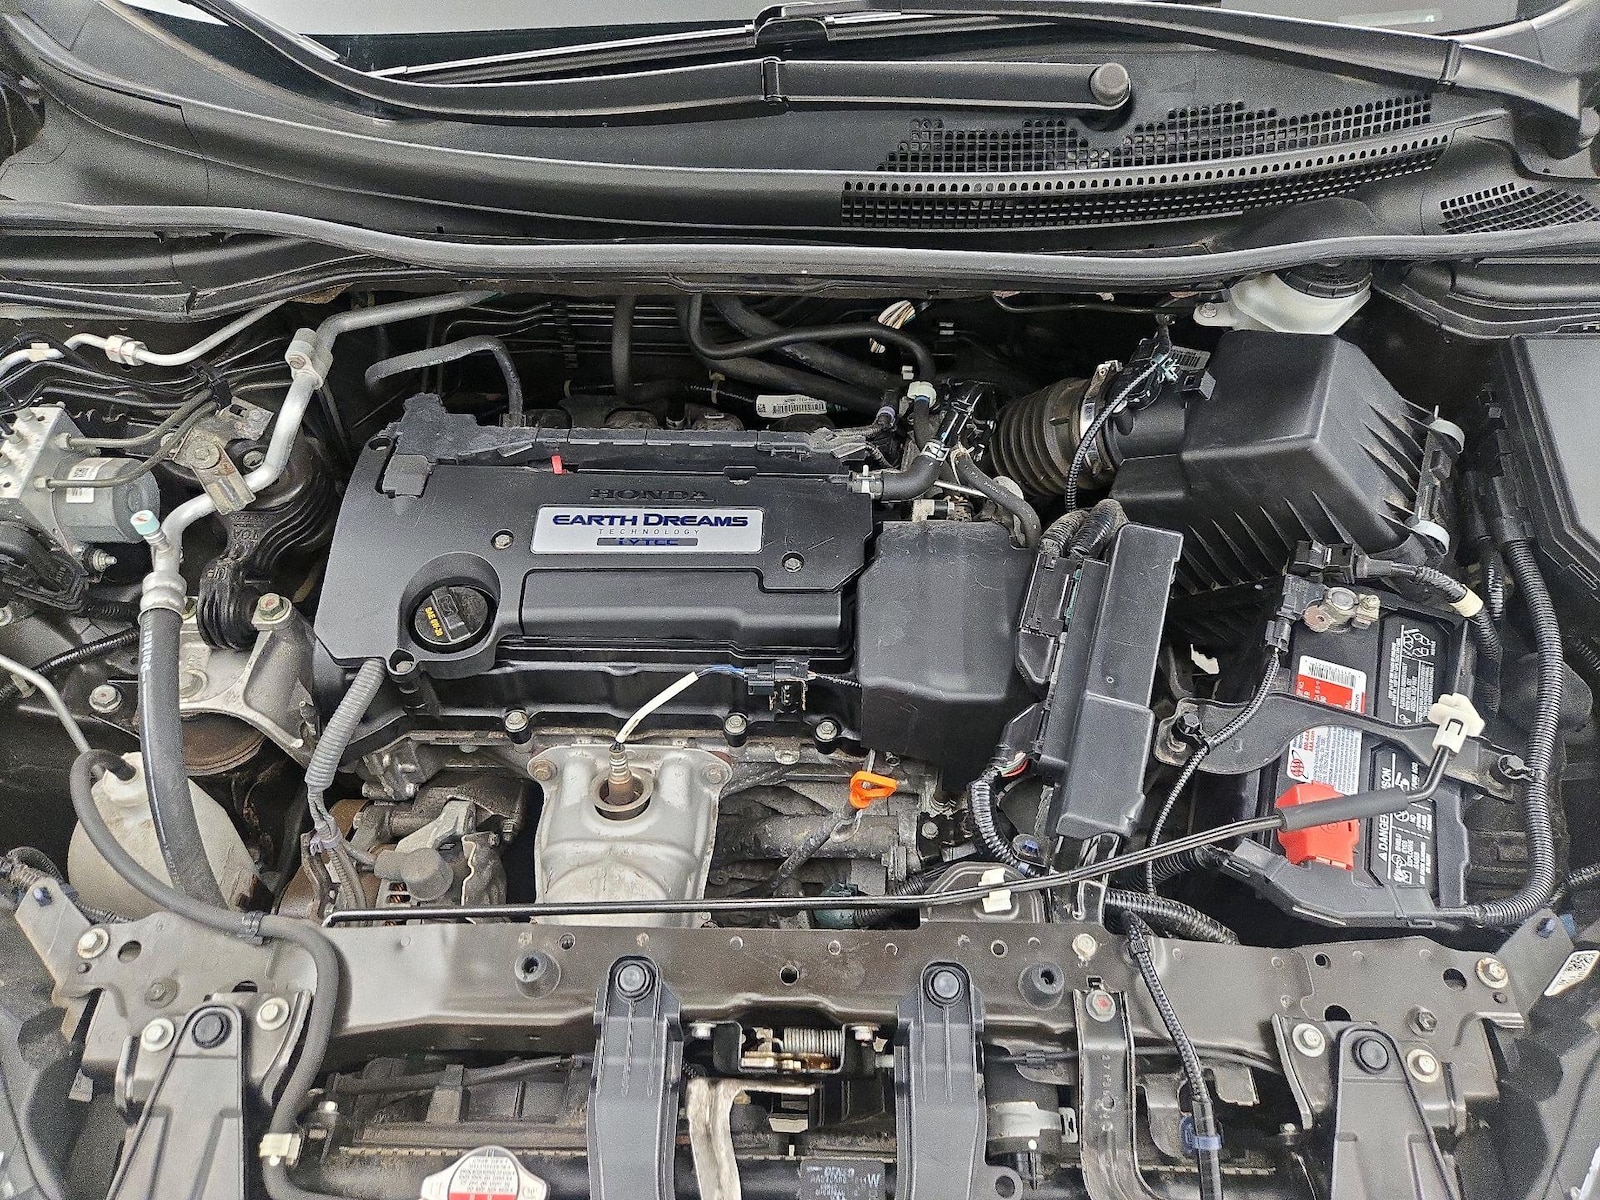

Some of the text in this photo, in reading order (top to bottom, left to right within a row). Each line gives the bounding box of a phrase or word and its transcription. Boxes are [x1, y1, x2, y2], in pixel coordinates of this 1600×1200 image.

[590, 489, 714, 502] HONDA
[552, 513, 748, 527] EARTH DREAMS
[425, 606, 436, 619] SAE
